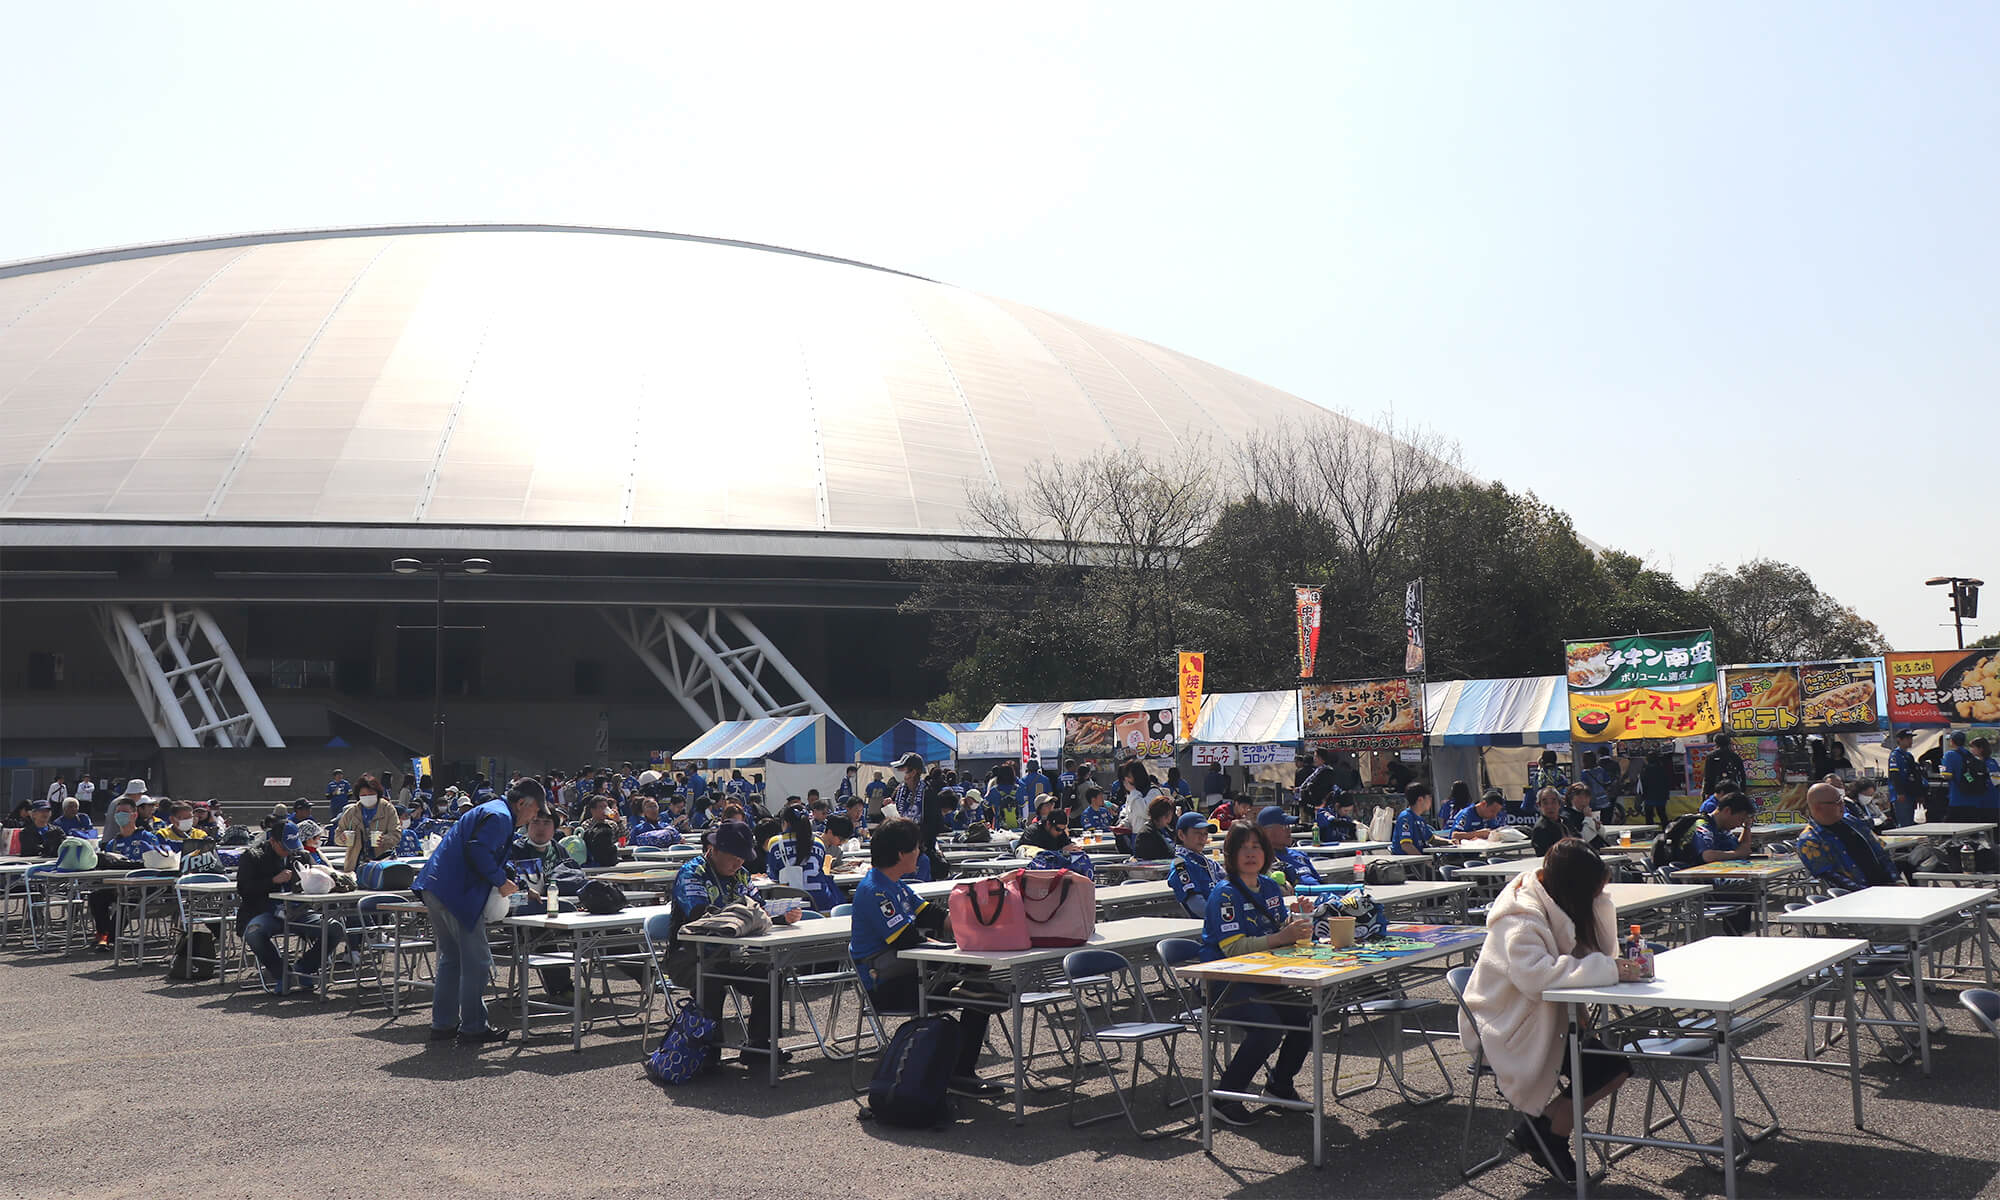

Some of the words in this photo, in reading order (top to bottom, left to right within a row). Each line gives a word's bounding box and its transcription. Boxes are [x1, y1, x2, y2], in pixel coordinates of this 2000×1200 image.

[1606, 640, 1713, 671] チキン南蛮
[1893, 676, 1938, 691] ネギ塩
[1331, 689, 1385, 704] 極上中津
[1895, 685, 1985, 706] ホルモン鉄板
[1318, 697, 1410, 727] からあげ
[1615, 695, 1681, 713] ロースト
[1624, 713, 1697, 731] ビーフ丼
[1732, 707, 1800, 731] ポテト
[1136, 739, 1174, 757] うどん
[1199, 746, 1229, 754] ライス
[1241, 744, 1277, 753] さつまいも
[1196, 754, 1230, 764] コロッケ
[1243, 753, 1276, 764] コロッケ
[1507, 814, 1539, 824] Domi
